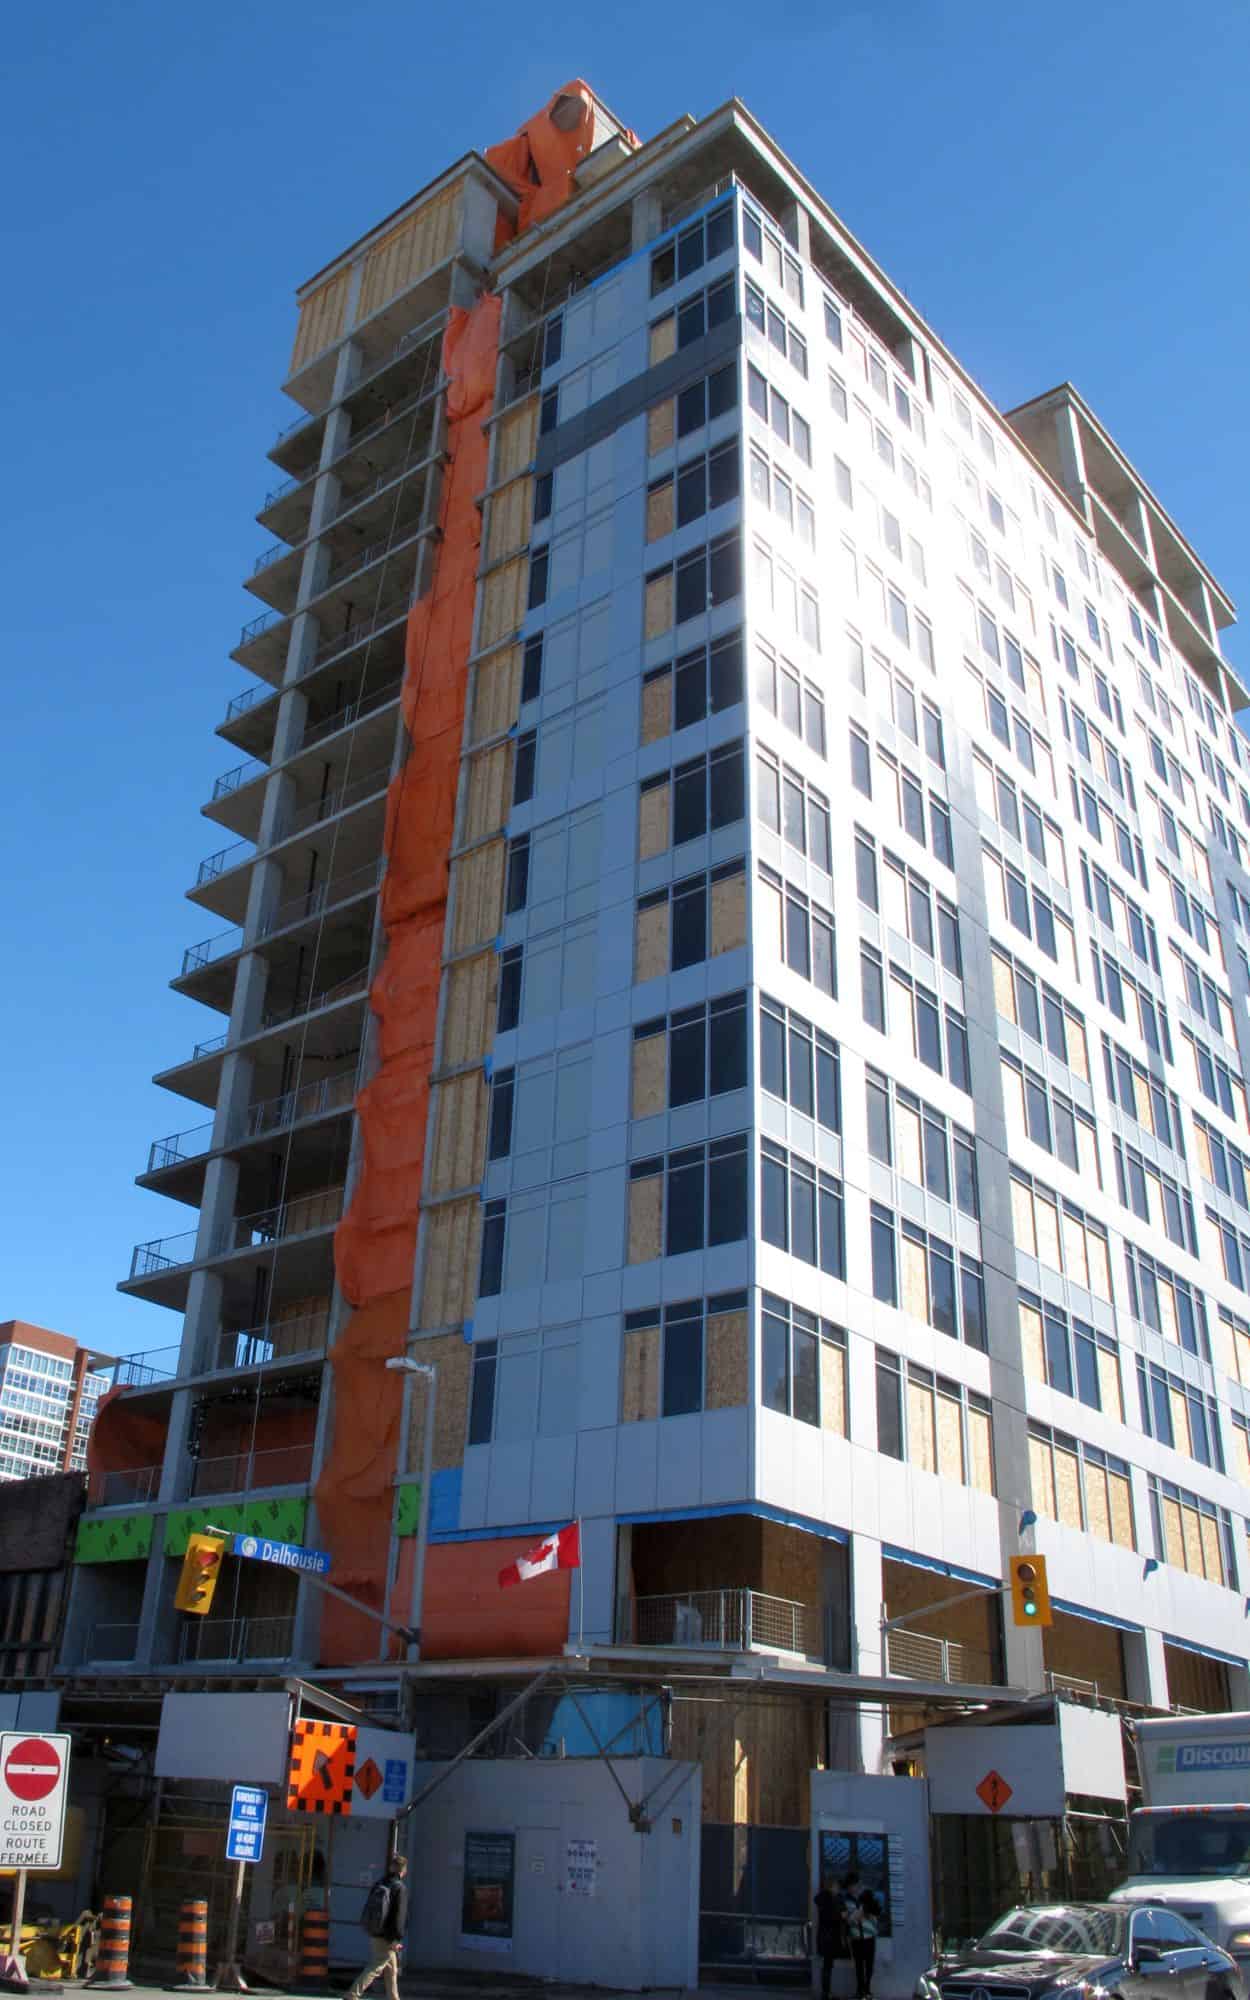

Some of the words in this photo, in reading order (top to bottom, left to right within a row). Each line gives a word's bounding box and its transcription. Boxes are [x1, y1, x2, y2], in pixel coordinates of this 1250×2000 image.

[262, 1543, 324, 1573] Dalhousie
[12, 1805, 46, 1816] ROAD
[4, 1820, 52, 1832] CLOSED
[6, 1837, 47, 1849] ROUTE
[0, 1851, 49, 1864] FERMÉE
